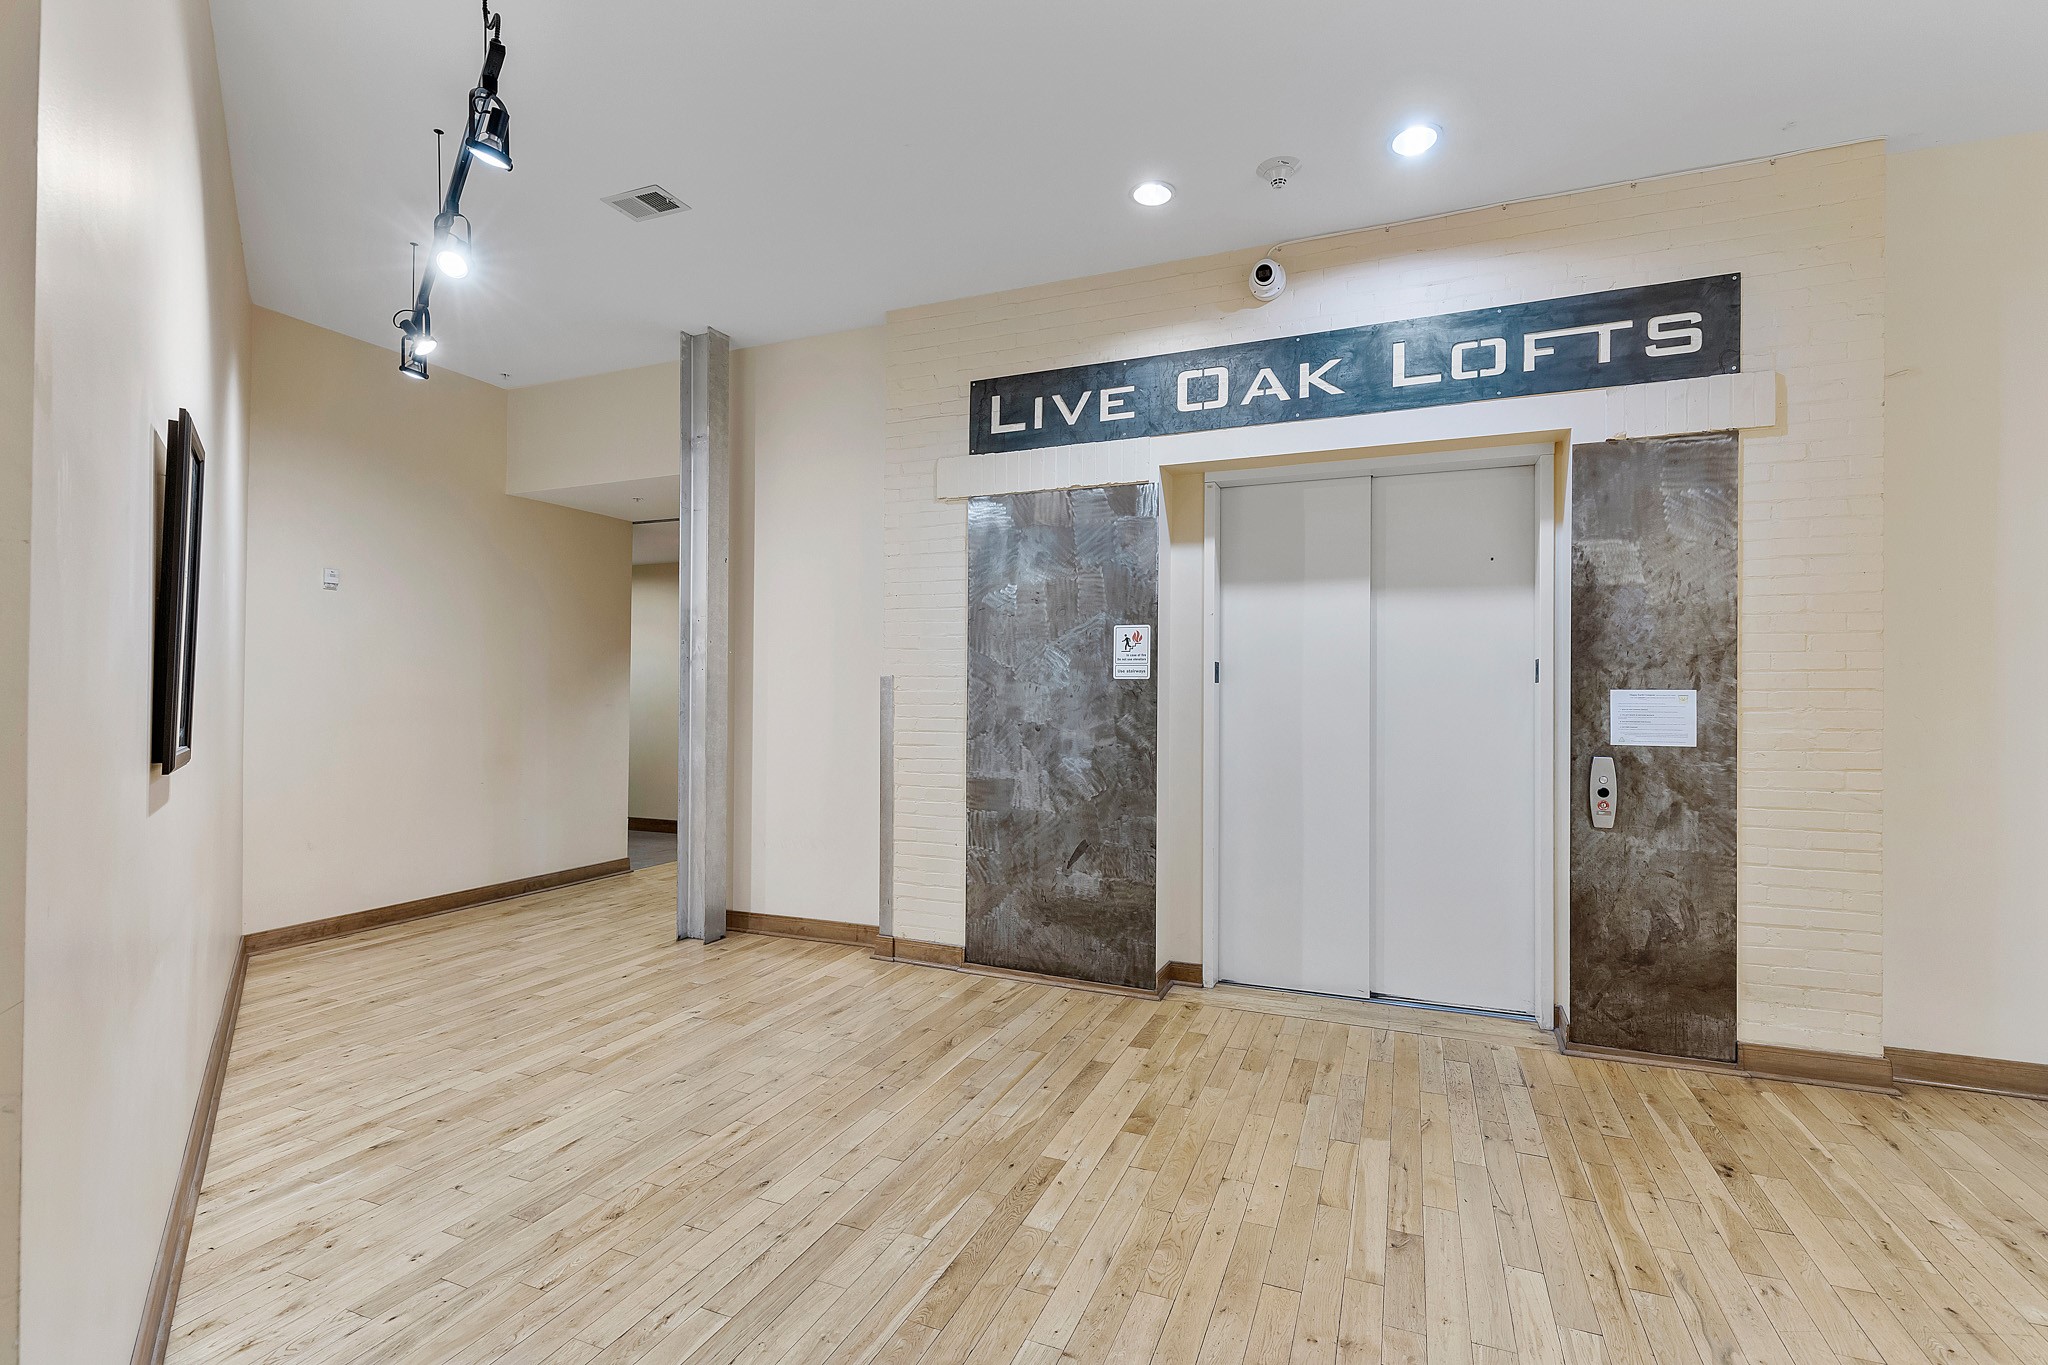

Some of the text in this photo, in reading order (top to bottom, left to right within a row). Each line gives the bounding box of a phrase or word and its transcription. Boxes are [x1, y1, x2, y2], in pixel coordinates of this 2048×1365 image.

[990, 311, 1703, 435] LIVE OAK LOFTS
